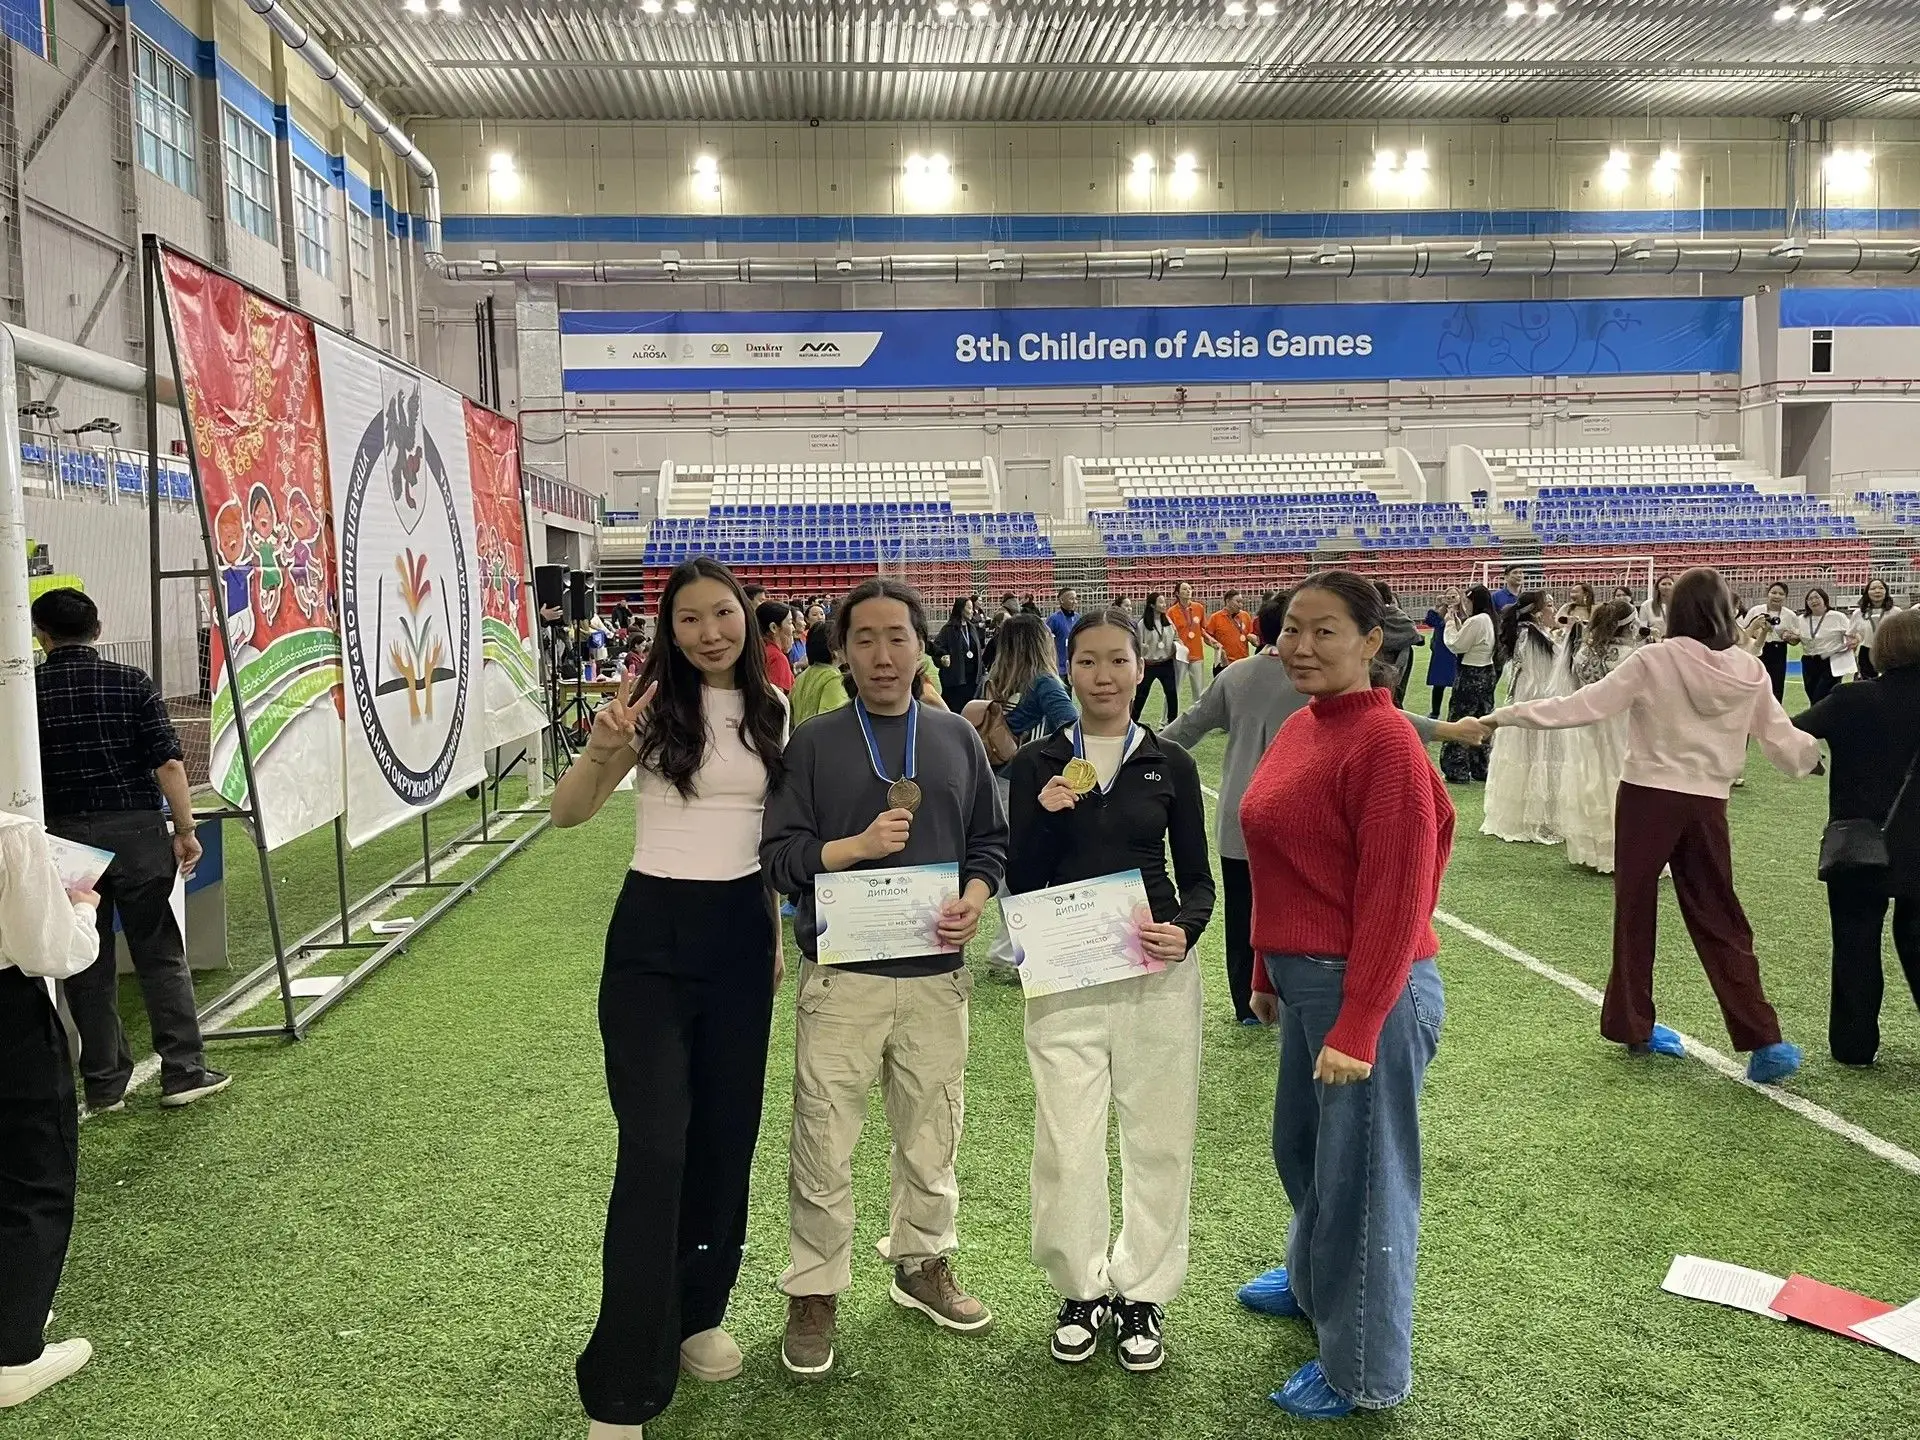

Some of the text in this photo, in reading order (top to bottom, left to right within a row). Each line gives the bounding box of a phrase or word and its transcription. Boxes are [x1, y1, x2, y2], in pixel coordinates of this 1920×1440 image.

[955, 329, 1372, 362] 8th Children of Asia Games
[345, 448, 370, 603] УПРАВЛЕНИЕ
[458, 557, 469, 642] ГОРОДА
[347, 609, 392, 775] ОБРАЗОВАНИЯ
[434, 650, 469, 788] АДМИНИСТРАЦИИ
[391, 765, 434, 798] ОКРУЖНОЙ
[1144, 771, 1161, 781] alo
[867, 888, 908, 897] ДИПЛОМ
[1055, 902, 1095, 916] ДИПЛОМ
[1086, 936, 1108, 944] МЕСТО
